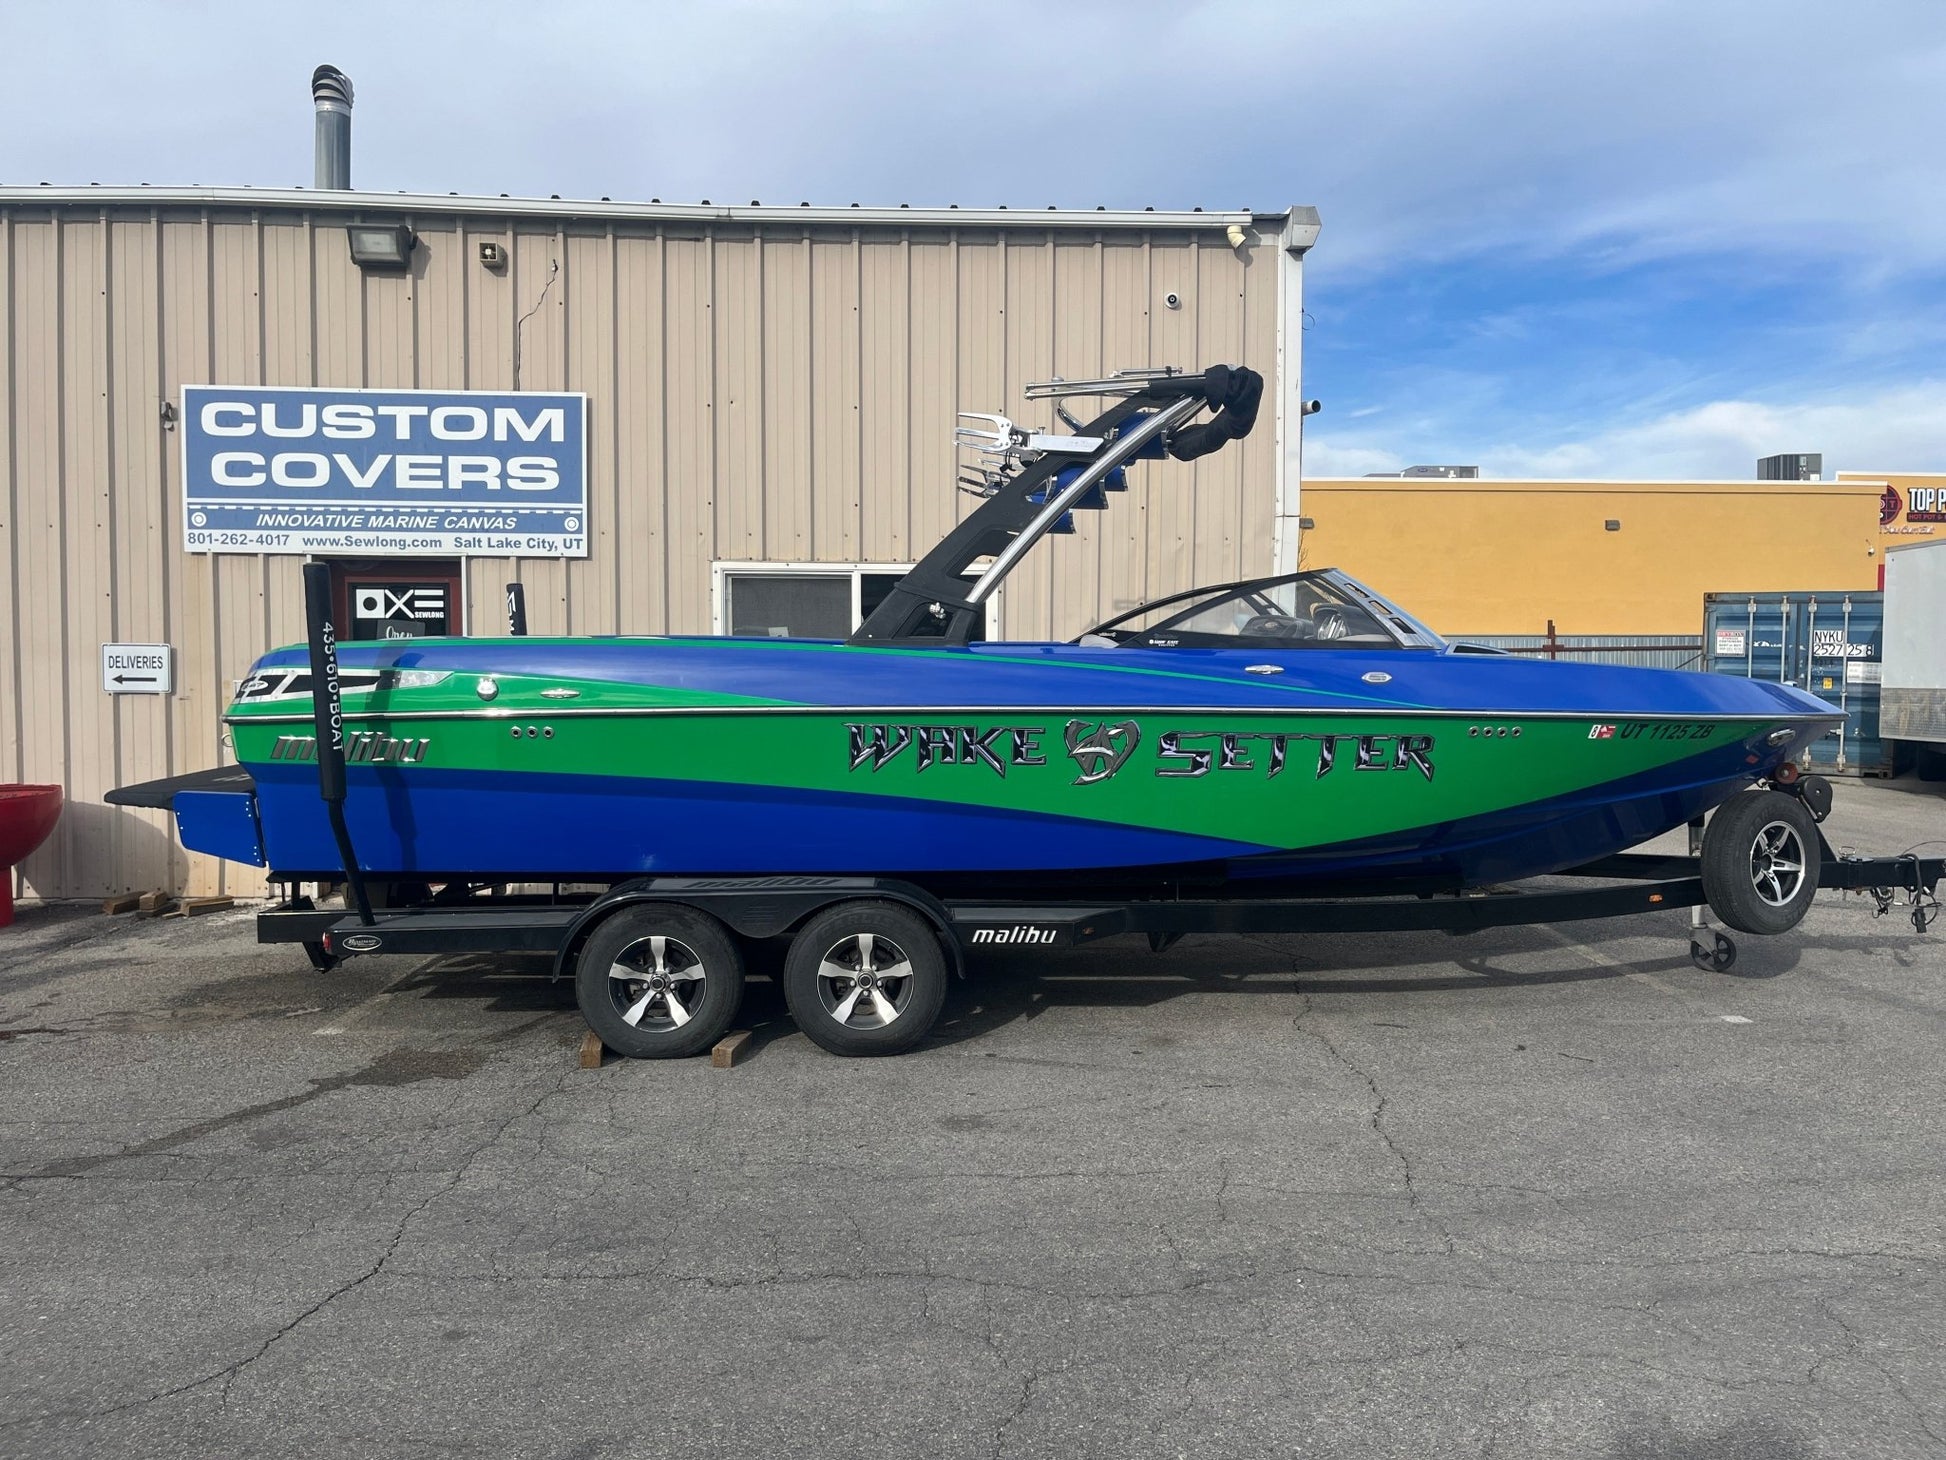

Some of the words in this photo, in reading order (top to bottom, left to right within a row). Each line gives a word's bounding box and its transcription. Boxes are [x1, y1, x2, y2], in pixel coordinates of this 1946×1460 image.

[201, 402, 564, 442] CUSTOM
[211, 452, 560, 490] COVERS
[1908, 488, 1935, 511] TOP
[256, 514, 364, 528] INNOVATIVE
[367, 515, 439, 529] MARINE
[444, 517, 517, 530] CANVAS
[188, 532, 290, 546] 801-262-4017
[302, 535, 442, 550] www.Sewlong.com
[454, 536, 482, 549] Salt
[487, 538, 521, 549] Lake
[526, 538, 558, 552] City,
[563, 538, 583, 550] UT
[1814, 631, 1844, 642] NYKU
[1866, 645, 1873, 656] 8
[108, 655, 163, 669] DELIVERIES
[1620, 723, 1648, 740] UT
[1650, 724, 1691, 740] 1125
[271, 731, 430, 762] mlibu
[843, 722, 1047, 779] WAKE
[1155, 729, 1435, 782] SETTER
[971, 925, 1057, 944] malibu
